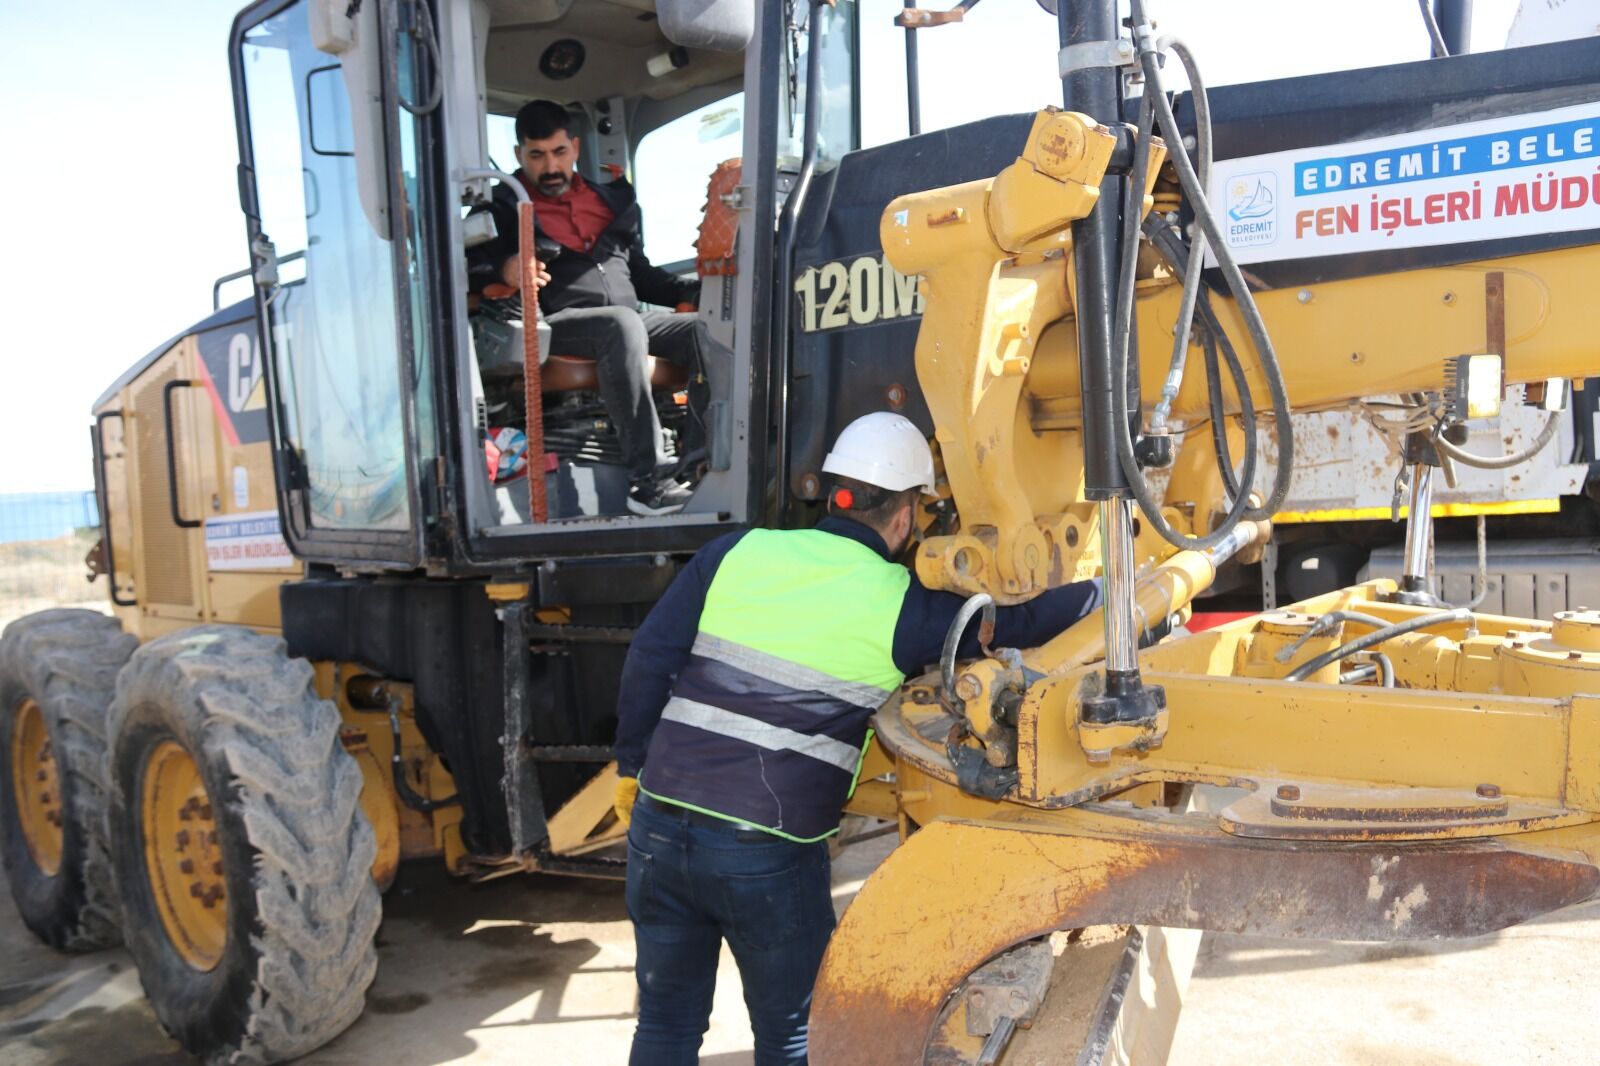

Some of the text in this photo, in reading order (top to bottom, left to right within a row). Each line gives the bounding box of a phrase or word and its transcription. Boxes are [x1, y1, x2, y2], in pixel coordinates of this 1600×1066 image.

[1302, 127, 1593, 190] EDREMİT BELE
[1230, 219, 1273, 235] EDREMİT
[1295, 204, 1359, 239] FEN
[1371, 180, 1482, 237] İŞLERİ
[794, 255, 927, 332] 120M
